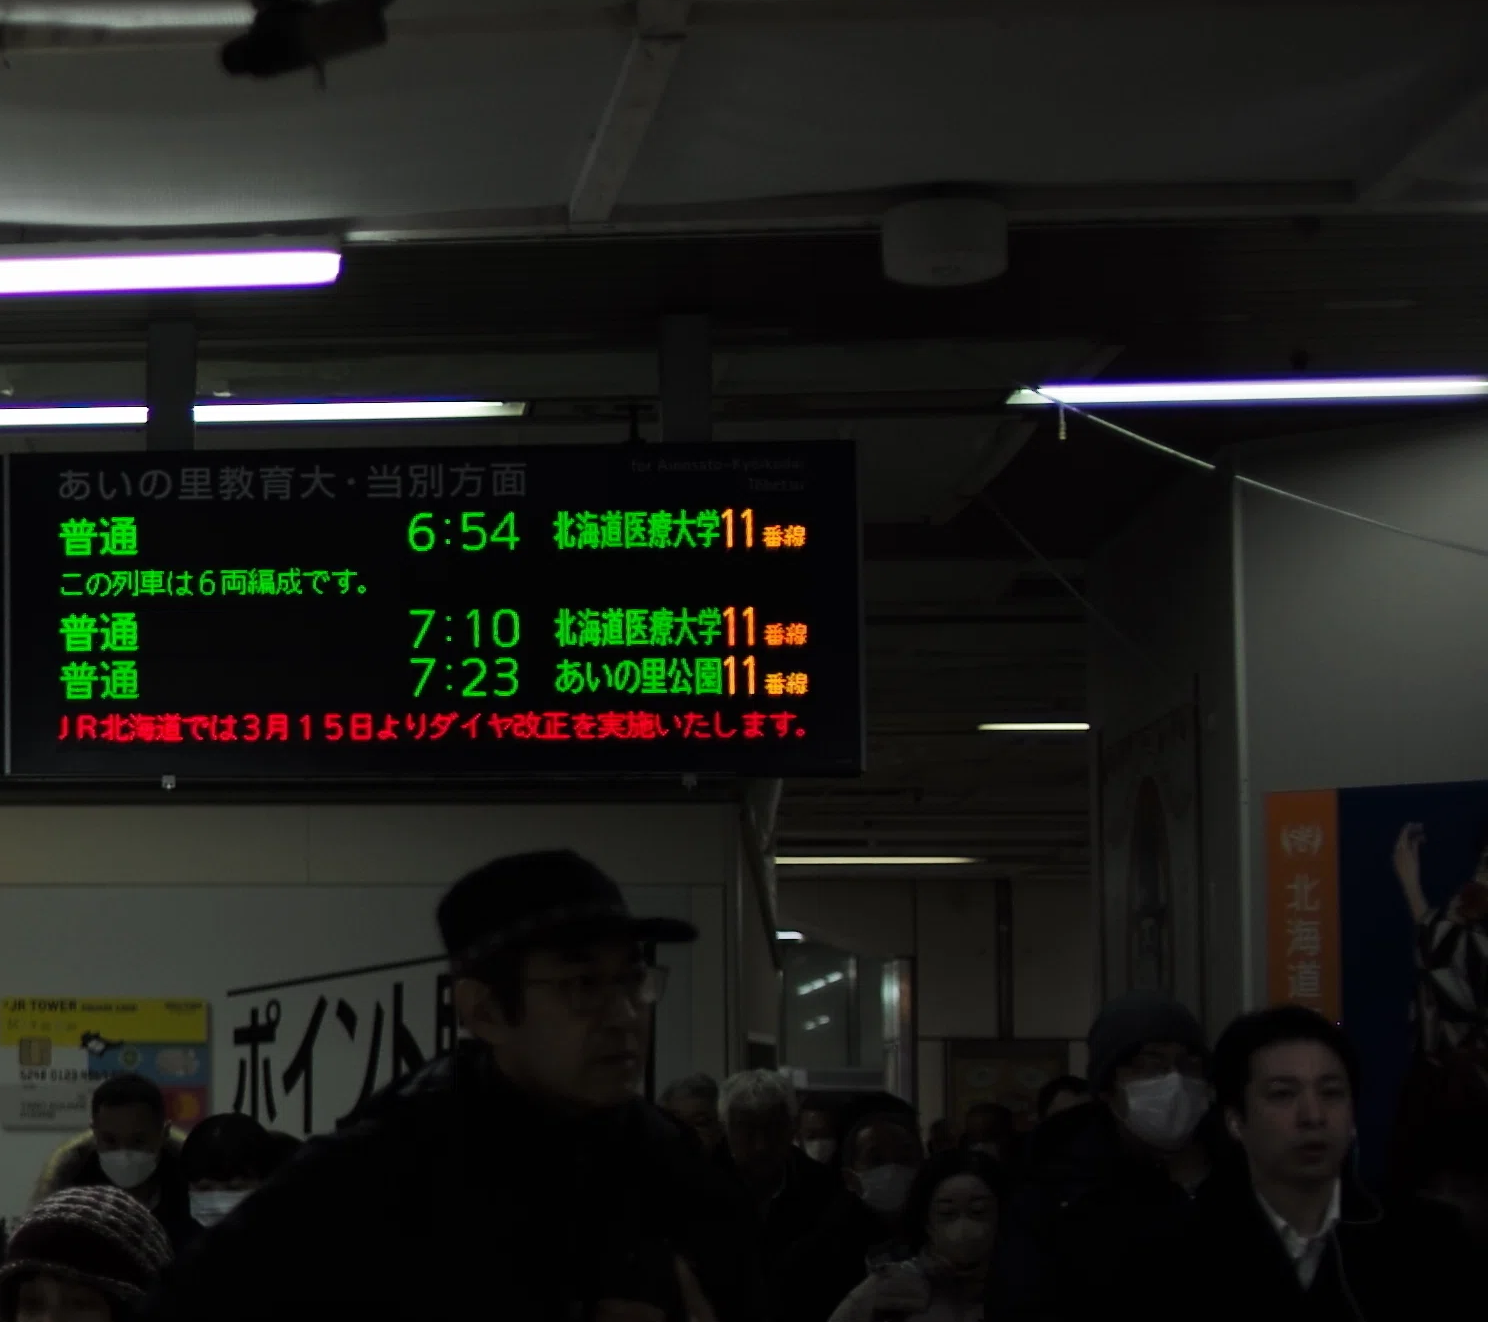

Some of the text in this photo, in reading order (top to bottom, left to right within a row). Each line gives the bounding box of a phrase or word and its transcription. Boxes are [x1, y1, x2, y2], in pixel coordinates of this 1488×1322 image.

[58, 462, 528, 503] あいの里教育大・当別方面
[59, 517, 138, 555] 普通
[409, 512, 519, 551] 6:54
[553, 509, 719, 549] 北海道医療大学
[61, 568, 366, 596] この列車は6両編成です。
[60, 613, 138, 651] 普通
[410, 609, 519, 648] 7:10
[555, 607, 721, 646] 北海道医療大学
[60, 661, 139, 699] 普通
[410, 658, 518, 697] 7:23
[555, 658, 722, 694] あいの里公園
[1285, 873, 1323, 1001] 北海道
[30, 1000, 77, 1011] TOWER
